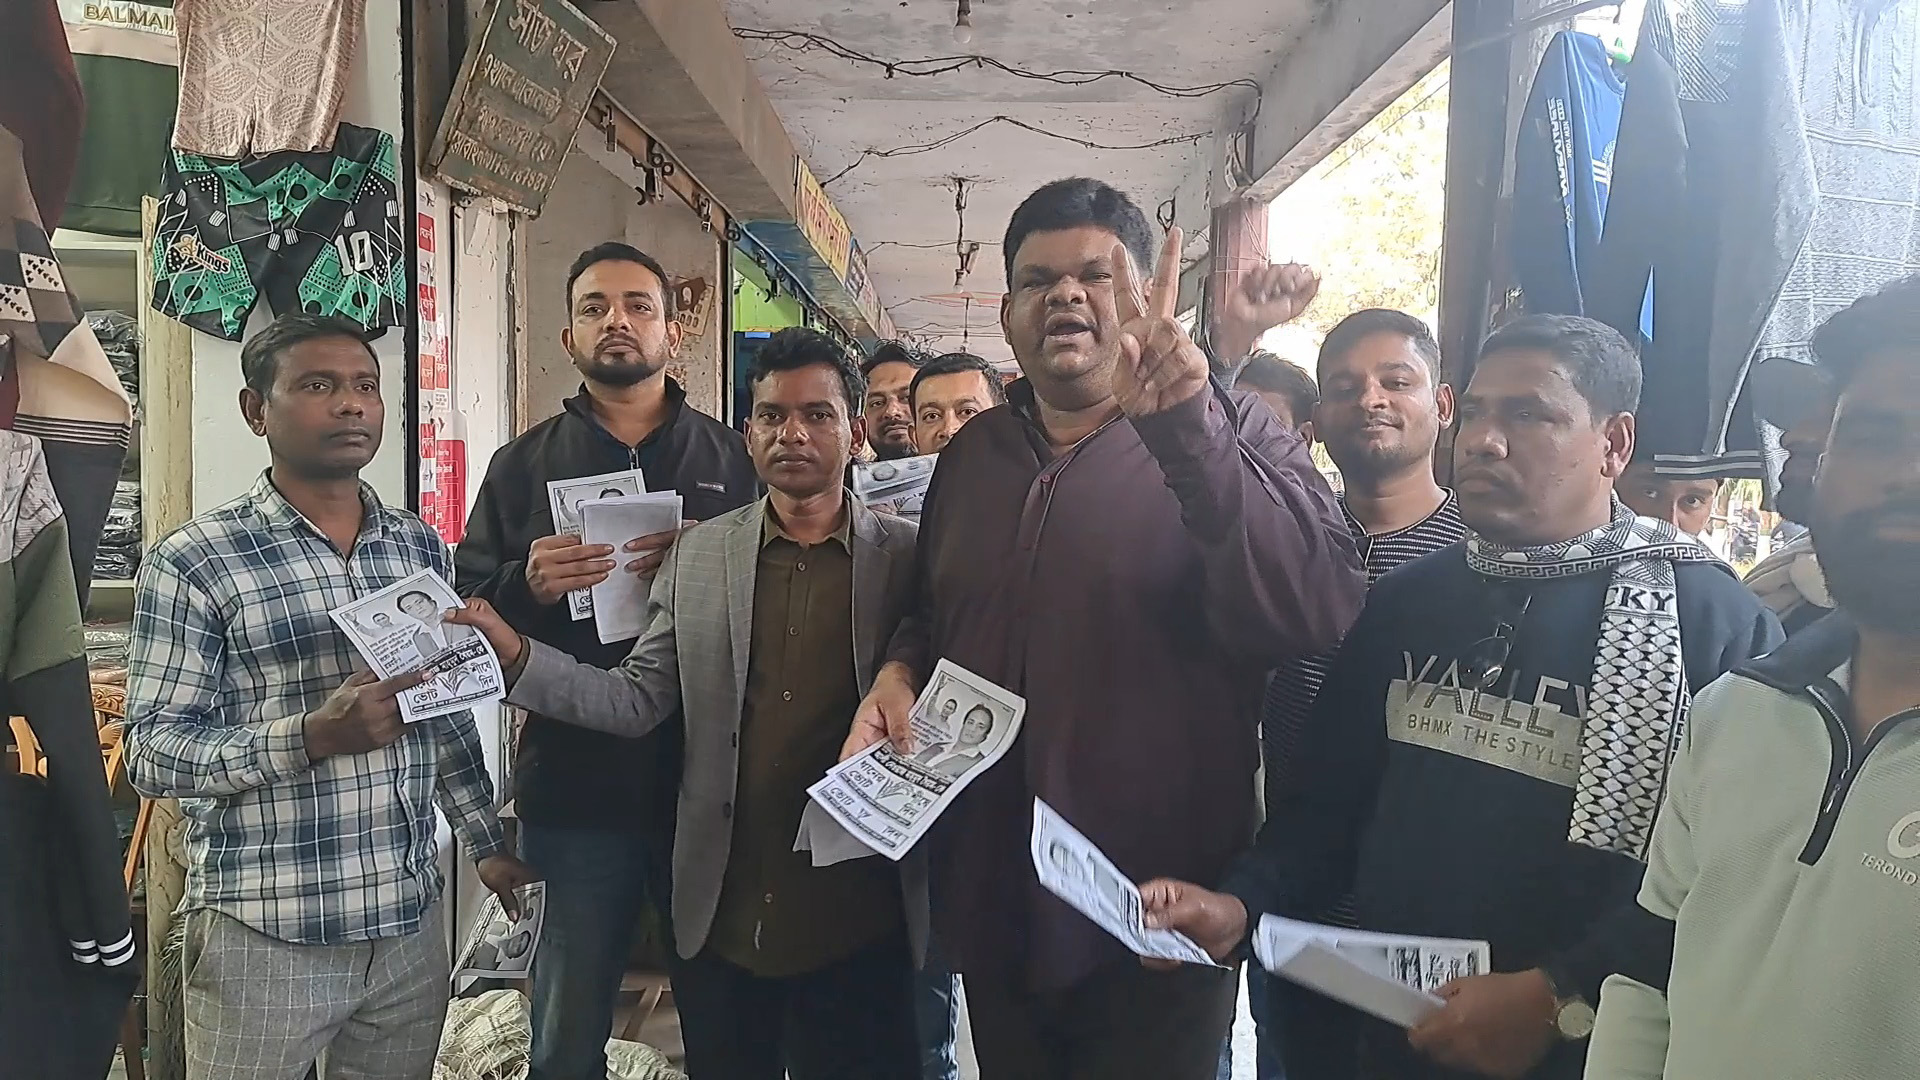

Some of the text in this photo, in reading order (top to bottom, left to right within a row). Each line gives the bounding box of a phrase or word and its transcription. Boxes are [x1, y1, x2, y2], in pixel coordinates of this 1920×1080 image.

[508, 0, 590, 82] সাজ ঘর
[1562, 121, 1573, 159] NEW YORK
[197, 243, 229, 272] Kings
[335, 231, 376, 276] 10
[413, 688, 439, 704] ভোট
[479, 675, 495, 689] দিন
[1407, 714, 1576, 771] BHMX THE STYLE
[849, 769, 873, 788] ভোট
[898, 802, 919, 818] দিন
